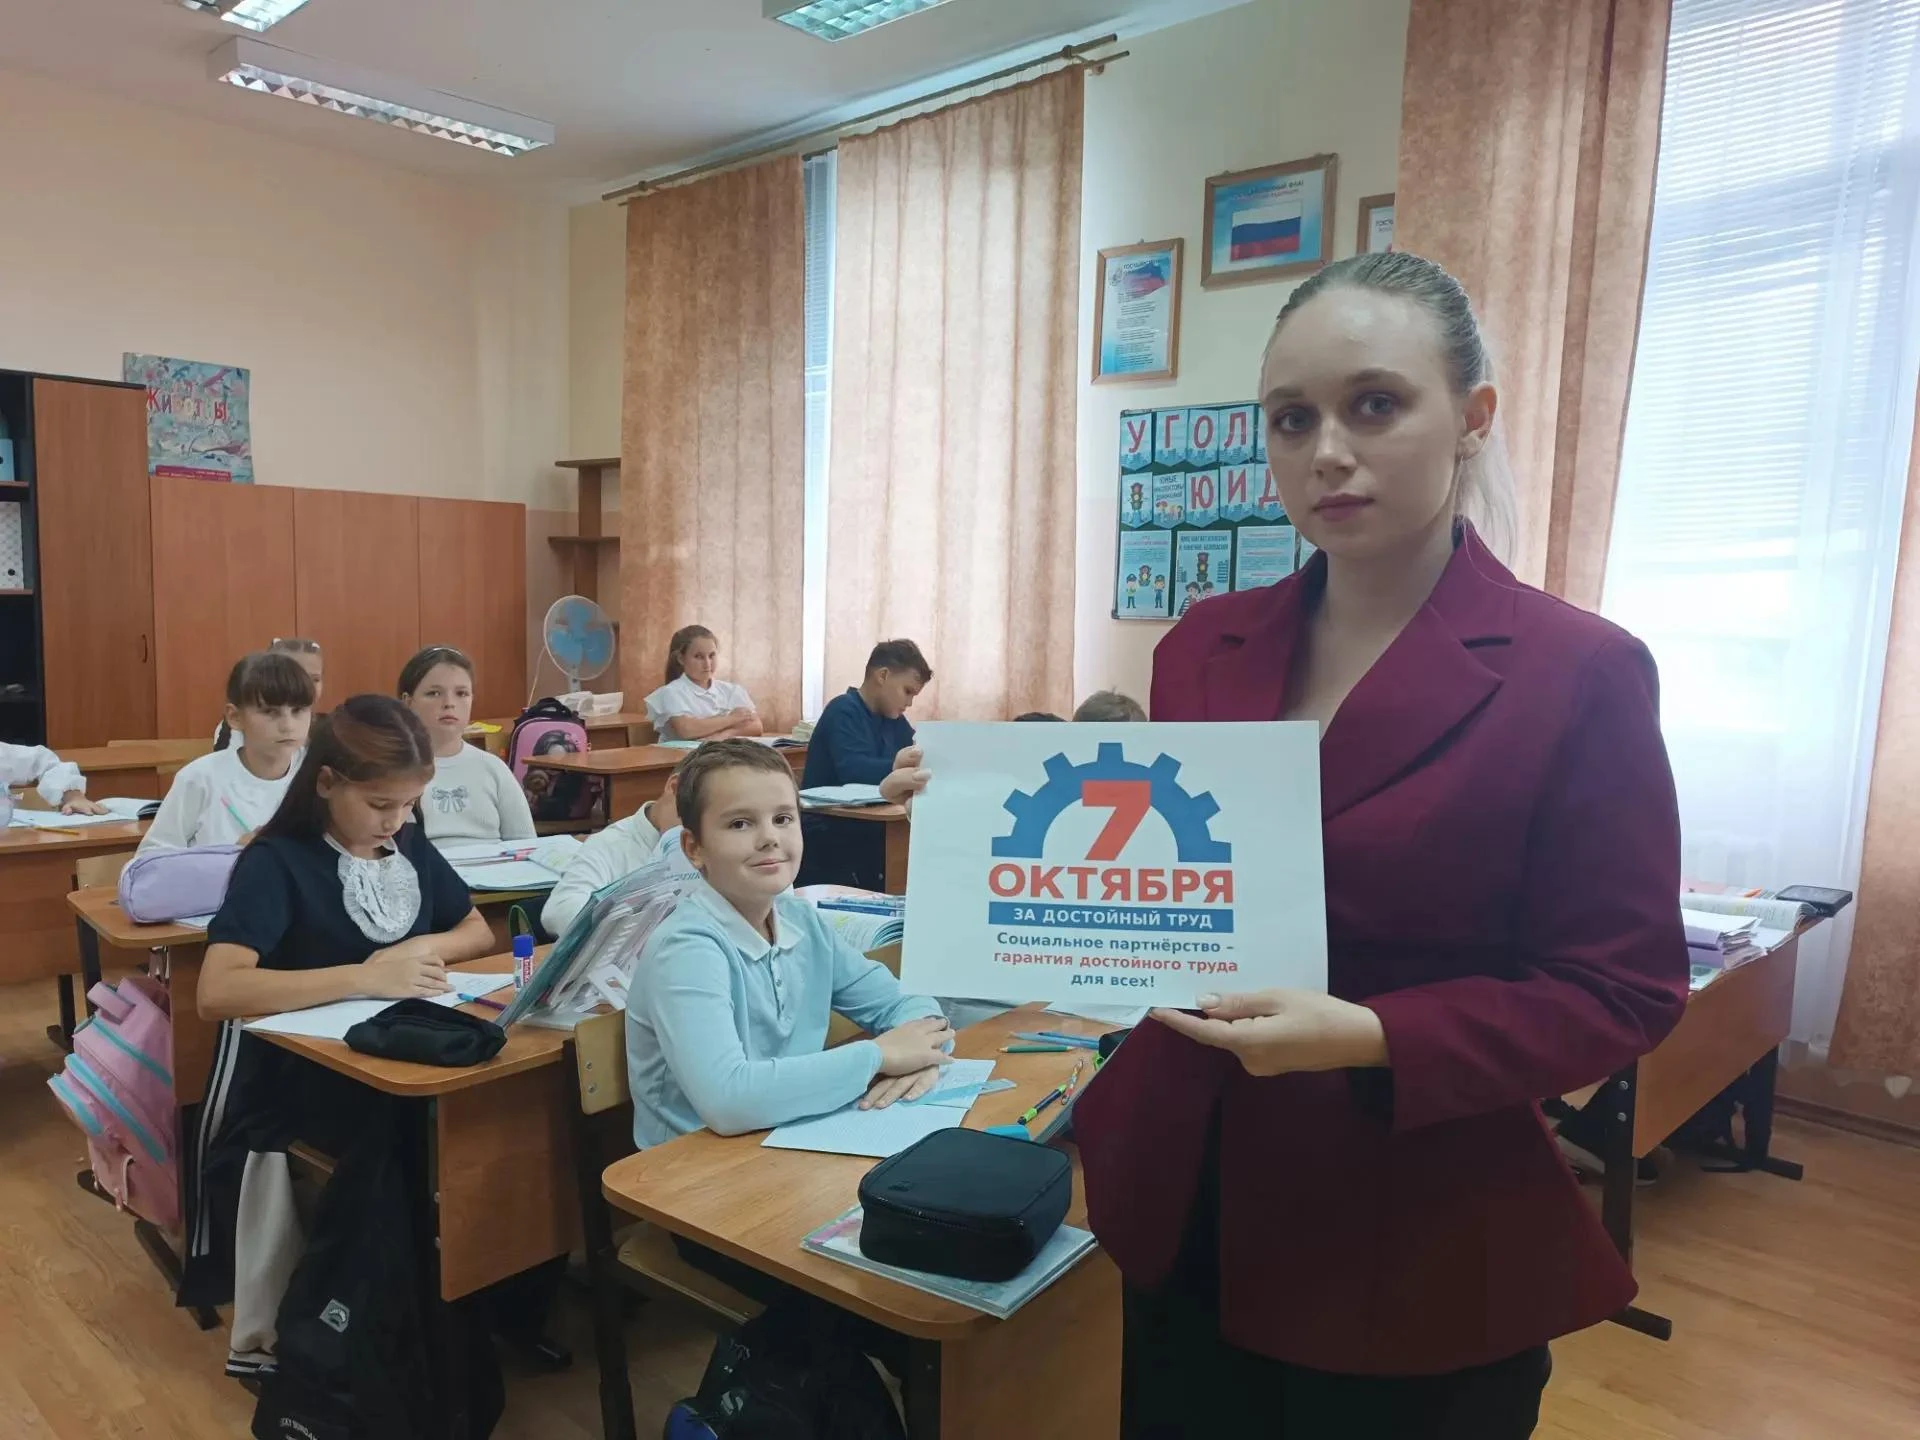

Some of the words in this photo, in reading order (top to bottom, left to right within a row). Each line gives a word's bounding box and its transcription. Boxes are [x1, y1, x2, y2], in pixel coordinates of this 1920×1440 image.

[1127, 412, 1247, 453] УГОЛ
[1082, 780, 1152, 860] 7
[989, 863, 1233, 903] ОКТЯБРЯ
[1014, 908, 1035, 922] ЗА
[1043, 907, 1160, 927] ДОСТОЙНЫЙ
[1167, 913, 1212, 929] ТРУД
[997, 933, 1103, 950] Социальное
[1109, 937, 1221, 954] партнёрство
[994, 953, 1073, 968] гарантия
[1080, 954, 1181, 972] достойного
[1188, 960, 1238, 975] труда
[1071, 974, 1104, 987] для
[1111, 974, 1154, 988] всех!
